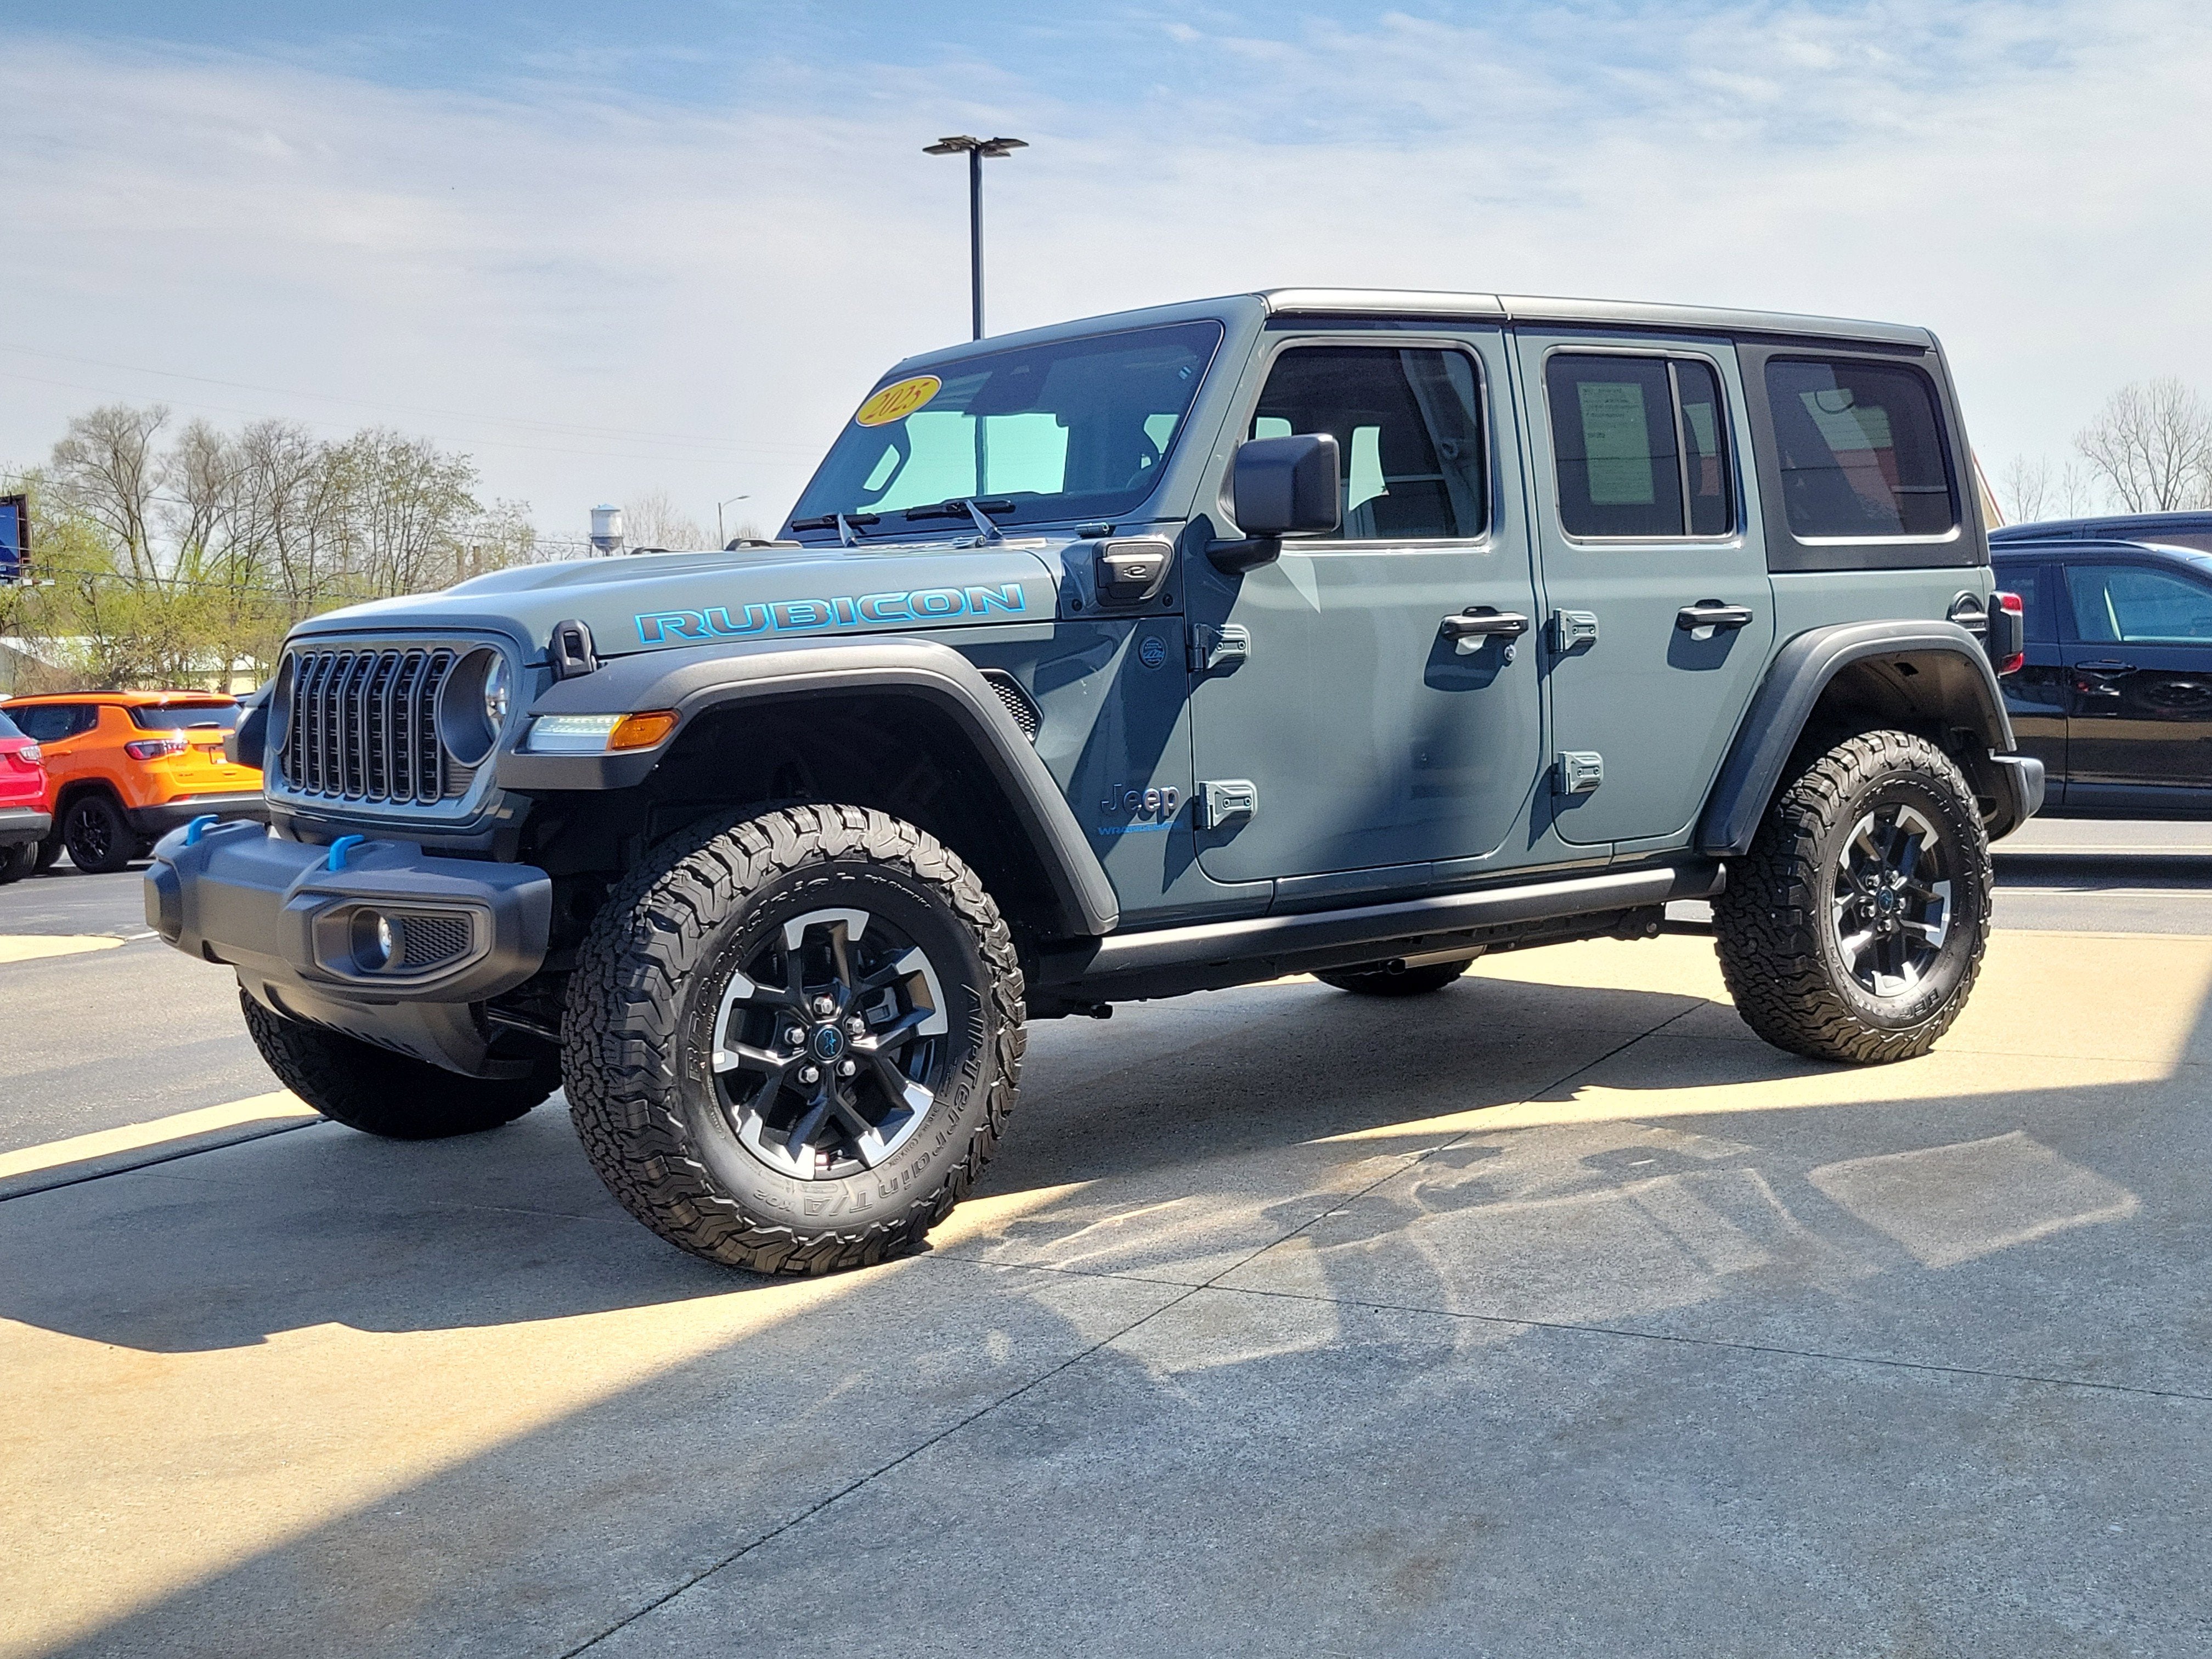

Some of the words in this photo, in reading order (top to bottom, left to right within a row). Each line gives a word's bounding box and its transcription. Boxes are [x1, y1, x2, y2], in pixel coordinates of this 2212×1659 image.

[864, 381, 931, 421] 2025
[635, 583, 1026, 644] RUBICON
[1101, 783, 1180, 817] Jeep
[804, 1191, 873, 1216] T/A
